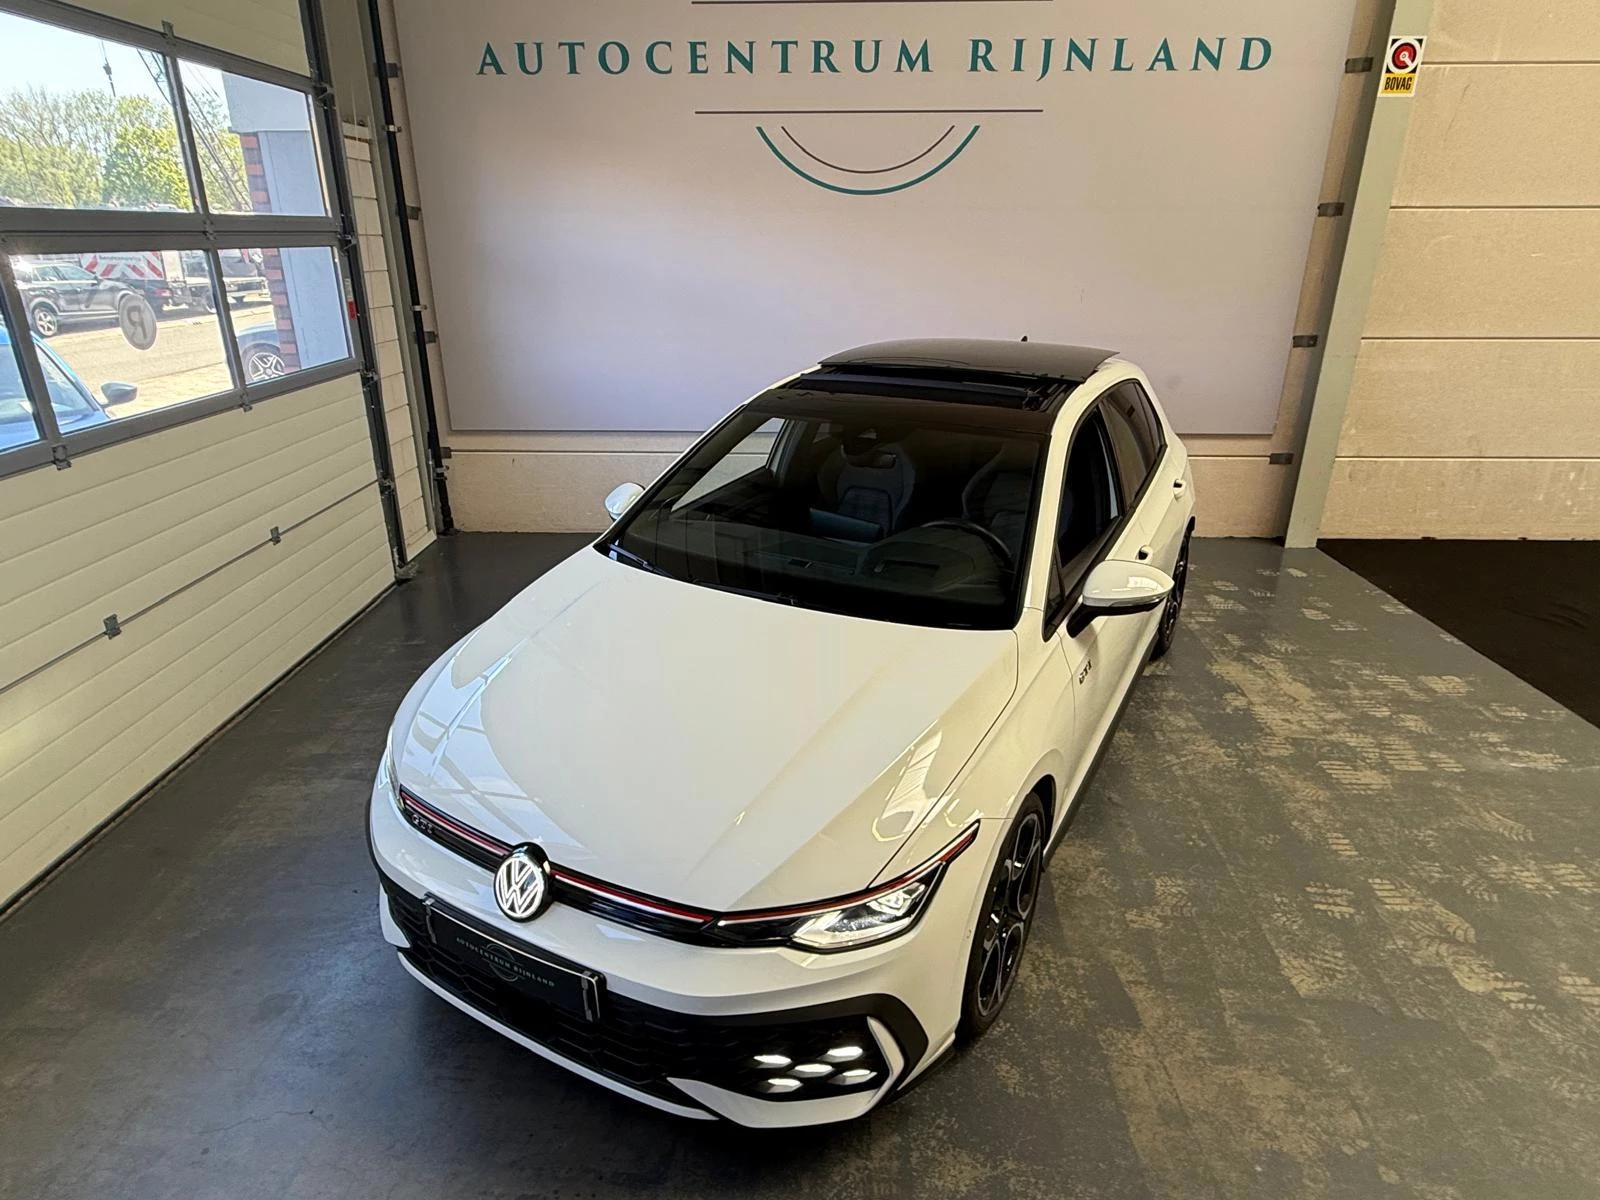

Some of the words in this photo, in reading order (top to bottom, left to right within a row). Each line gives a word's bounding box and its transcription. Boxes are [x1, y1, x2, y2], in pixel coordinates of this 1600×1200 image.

[476, 39, 934, 76] AUTOCENTRUM
[968, 37, 1274, 82] RIJNLAND
[1384, 77, 1412, 90] BOVAG
[411, 814, 433, 834] GTI
